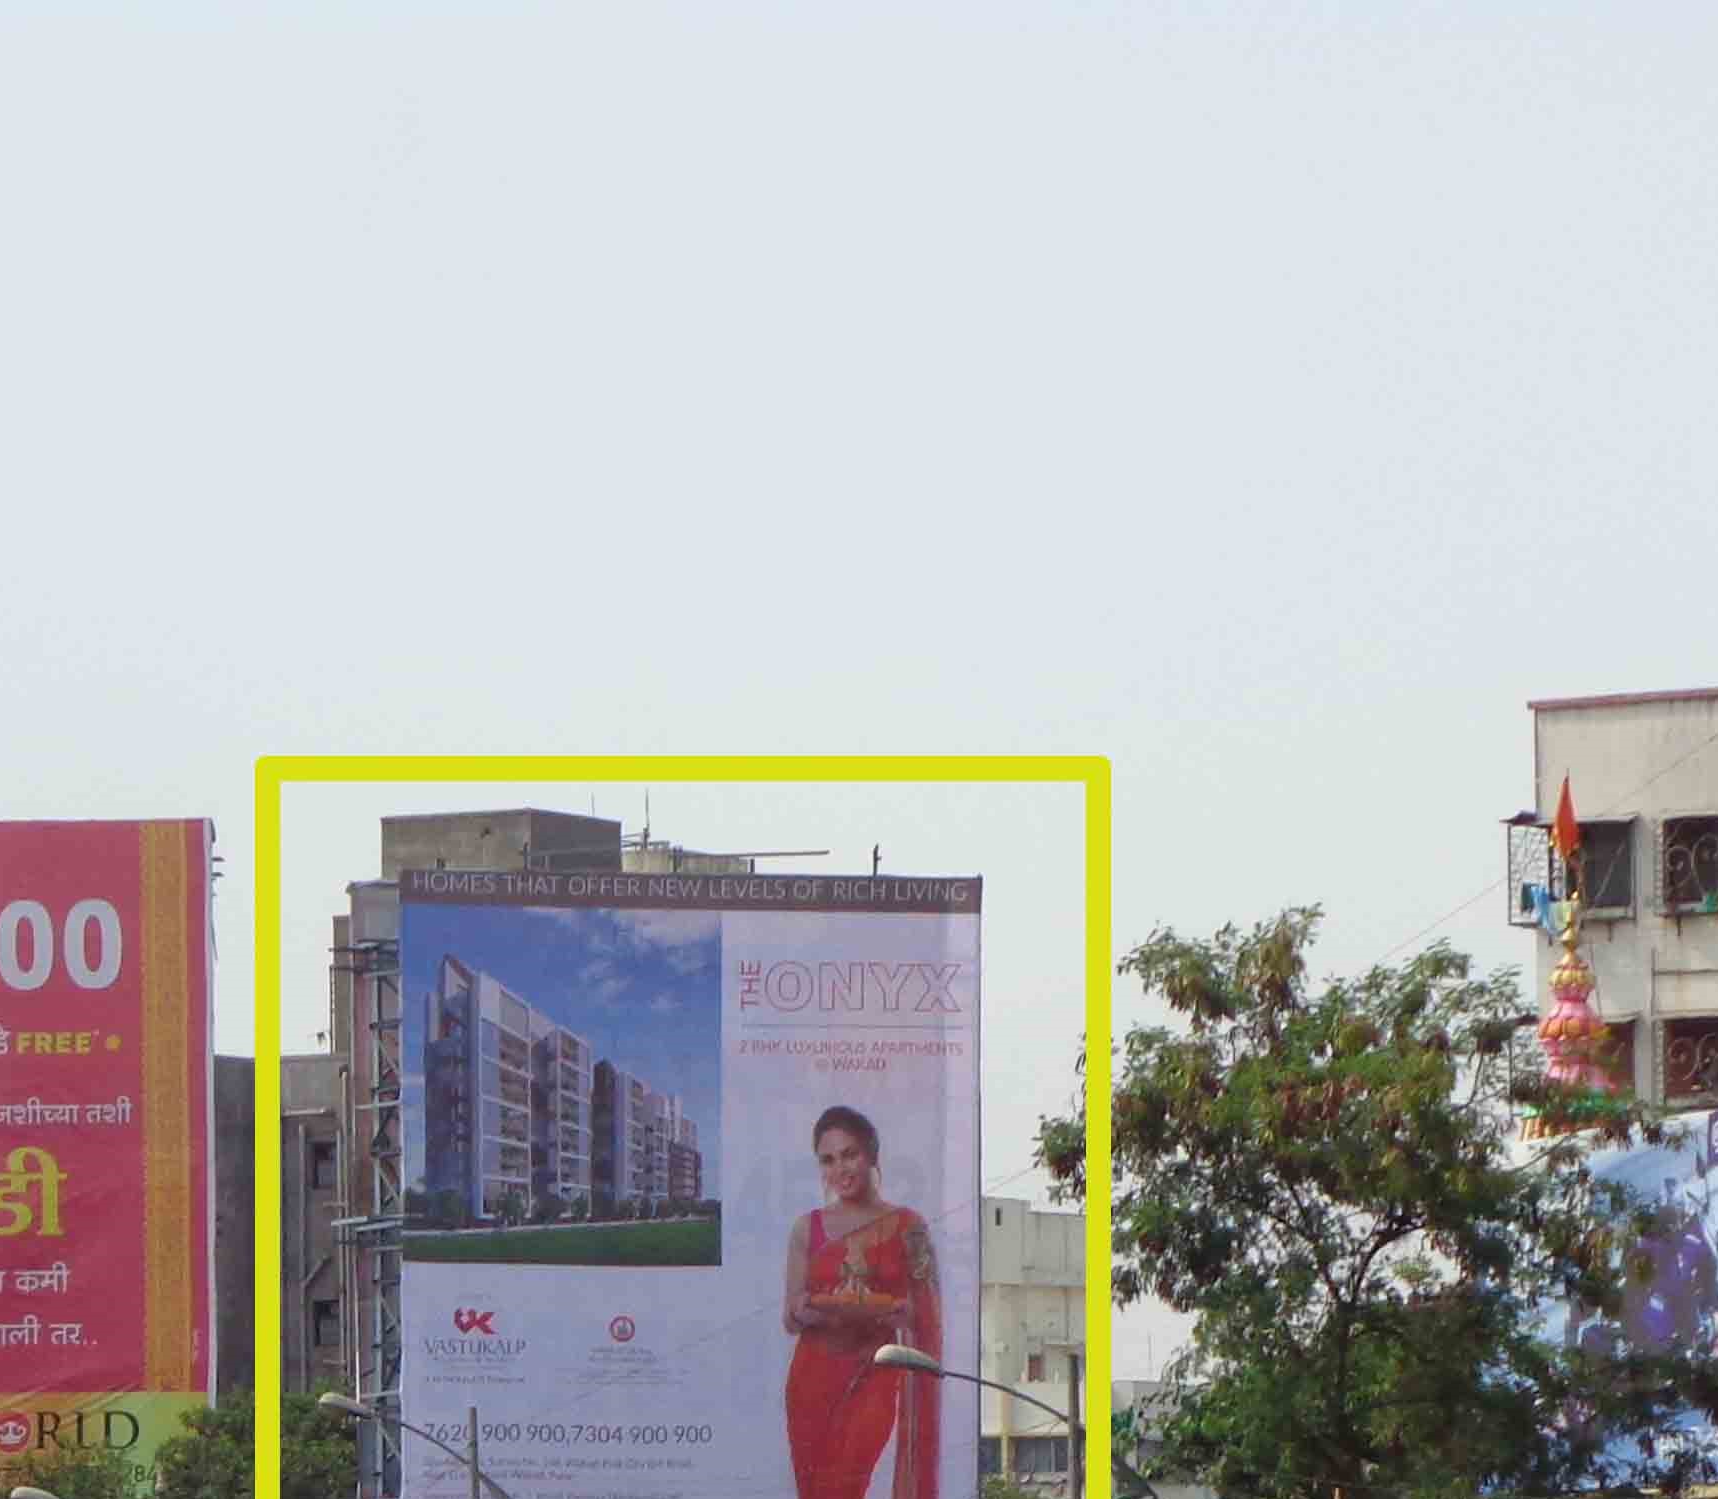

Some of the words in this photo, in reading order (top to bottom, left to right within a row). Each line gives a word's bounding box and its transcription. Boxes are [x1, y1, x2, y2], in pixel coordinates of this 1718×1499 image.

[413, 870, 495, 894] HOMES
[504, 874, 563, 895] THAT
[568, 876, 641, 897] OFFER
[648, 877, 702, 897] NEW
[708, 879, 786, 899] LEVELS
[793, 880, 826, 900] OF
[834, 880, 886, 900] RICH
[895, 881, 969, 902] LIVING
[739, 959, 762, 1010] THE
[764, 960, 962, 1013] ONYX
[871, 1041, 964, 1057] APARTMENTS
[85, 1095, 133, 1126] तशी
[15, 1263, 70, 1293] कमी
[424, 1338, 527, 1356] VASTUKALP
[482, 1424, 521, 1443] 900
[628, 1425, 668, 1445] 900
[674, 1424, 713, 1445] 900
